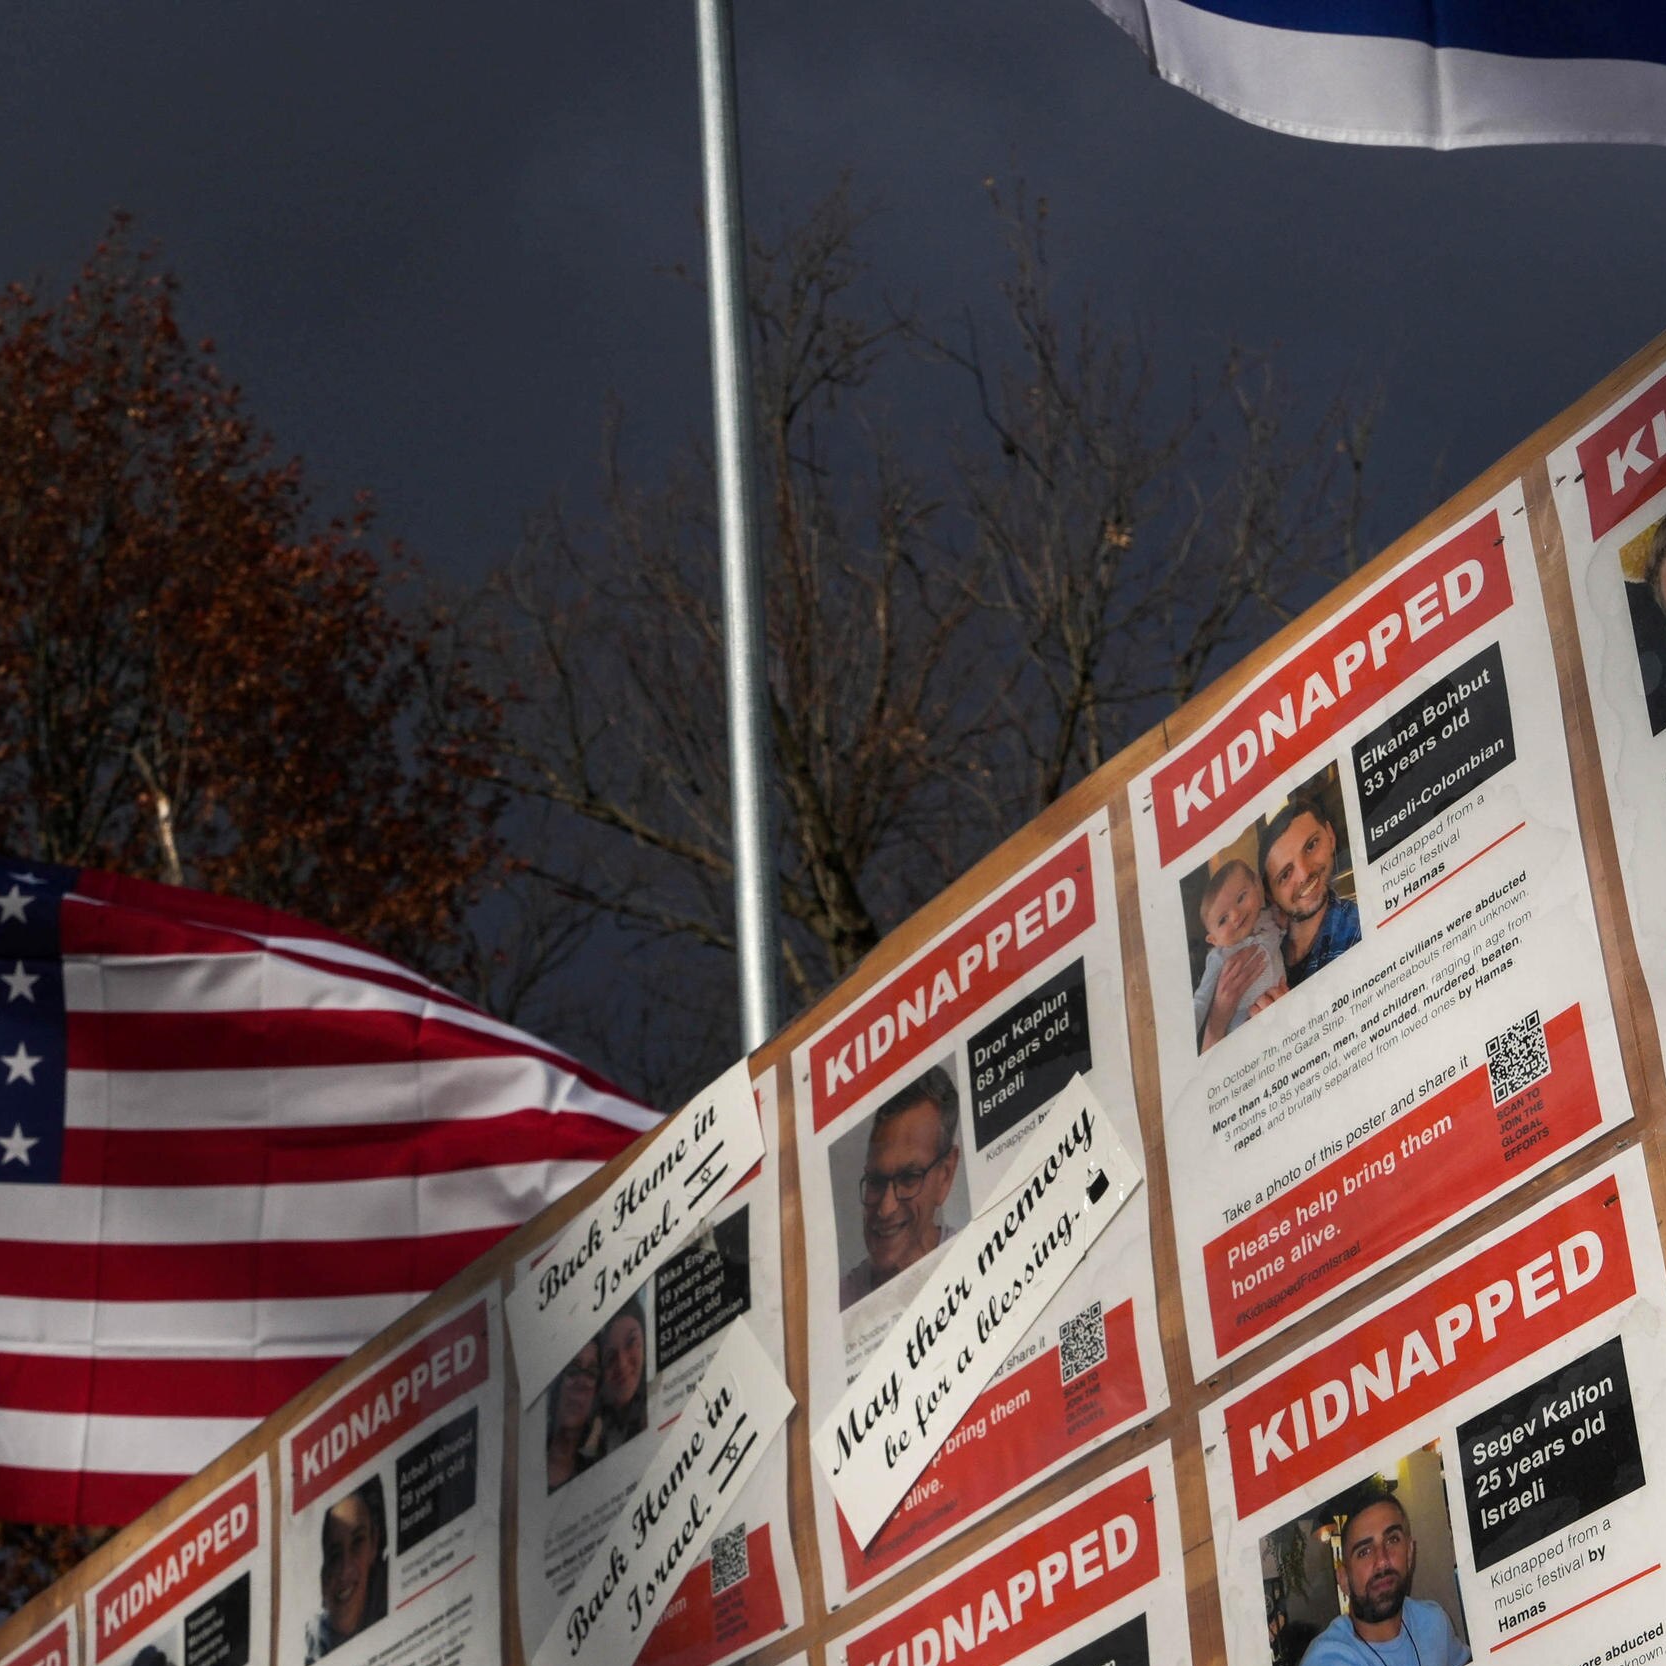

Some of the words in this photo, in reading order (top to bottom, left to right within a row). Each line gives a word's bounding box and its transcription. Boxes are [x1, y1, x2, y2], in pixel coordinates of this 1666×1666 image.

[1172, 559, 1485, 828] KIDNAPPED
[1359, 721, 1419, 773] Elkana
[1422, 668, 1491, 727] Bohbut
[1363, 770, 1385, 796] 33
[1388, 735, 1437, 784] years
[1441, 707, 1470, 740] old
[1370, 738, 1505, 842] Israeli-Colombian
[825, 877, 1077, 1097] KIDNAPPED
[973, 1032, 1009, 1069] Dror
[1011, 991, 1068, 1040] Kaplun
[975, 1070, 995, 1092] 68
[996, 1036, 1042, 1083] years
[1044, 1010, 1070, 1042] old
[978, 1070, 1028, 1118] Israeli
[1249, 1230, 1604, 1476] KIDNAPPED
[301, 1335, 476, 1486] KIDNAPPED
[1472, 1417, 1537, 1466] Segev
[1542, 1377, 1614, 1428] Kalfon
[1476, 1466, 1502, 1499] 25
[1505, 1438, 1566, 1488] years
[1571, 1409, 1606, 1446] old
[1480, 1477, 1546, 1530] Israeli
[103, 1502, 249, 1637] KIDNAPPED
